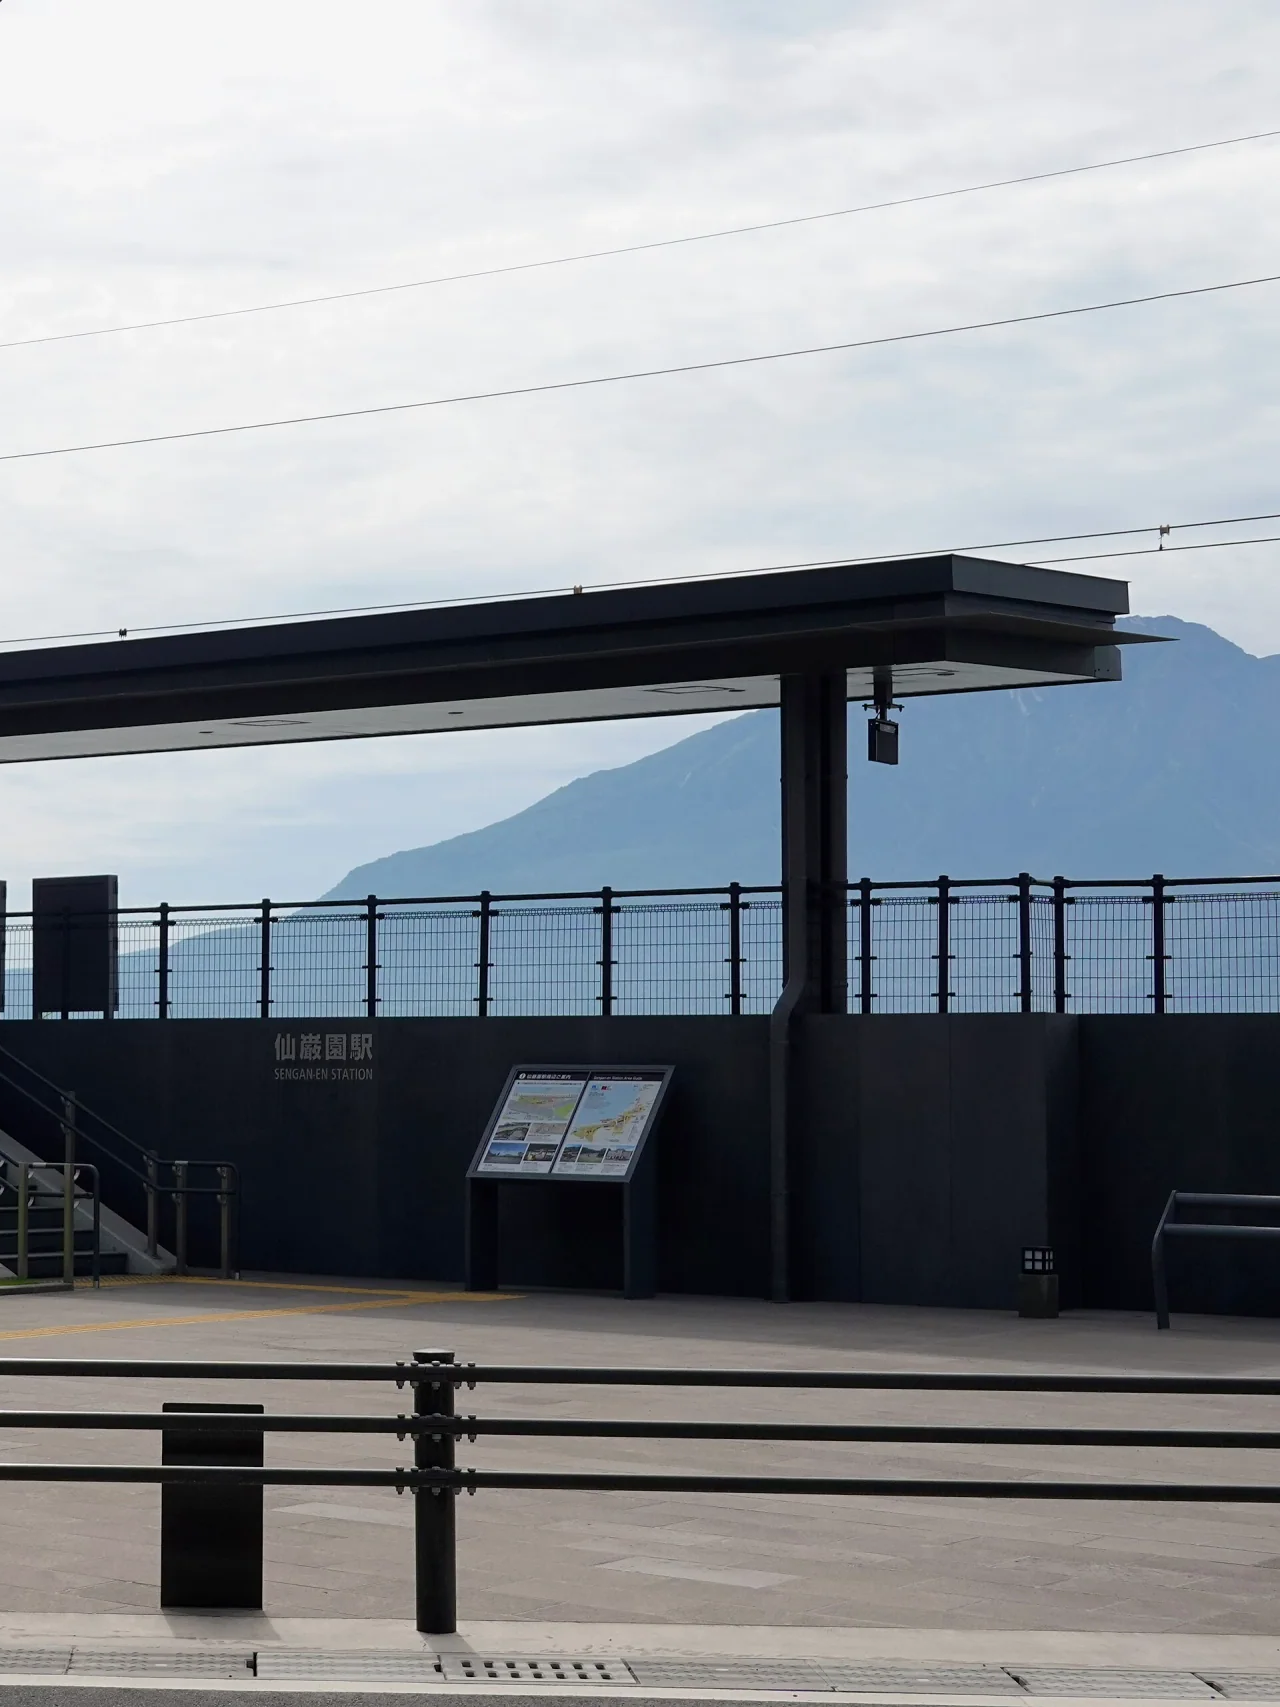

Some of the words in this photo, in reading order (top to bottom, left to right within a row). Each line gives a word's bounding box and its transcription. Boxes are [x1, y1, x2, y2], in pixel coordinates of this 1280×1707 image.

[274, 1032, 373, 1061] 仙巌園駅
[274, 1068, 328, 1080] SENGAN-EN
[331, 1068, 373, 1080] STATION
